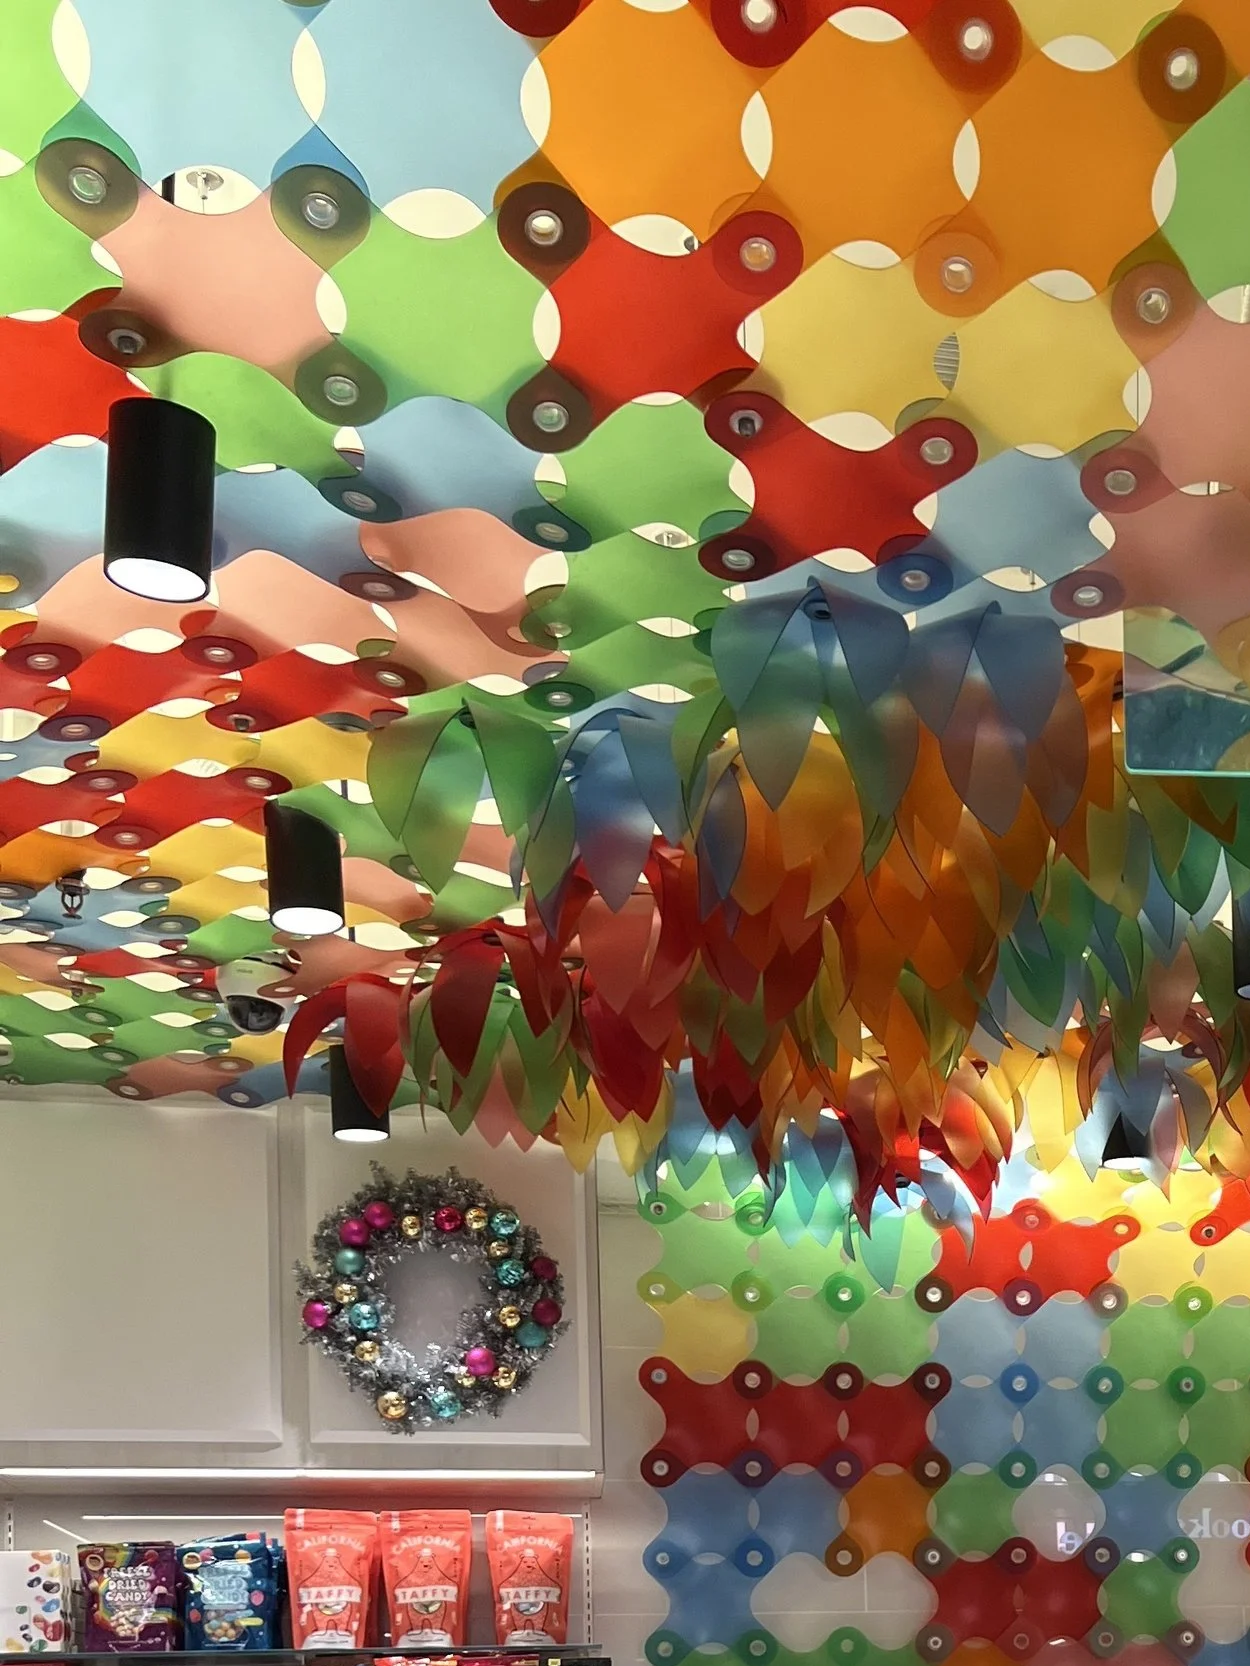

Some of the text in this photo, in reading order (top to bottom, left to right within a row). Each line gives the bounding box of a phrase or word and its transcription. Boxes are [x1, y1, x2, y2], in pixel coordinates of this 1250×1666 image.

[392, 1535, 461, 1554] CALIFORNIA
[108, 1578, 147, 1591] DRIED
[105, 1590, 149, 1602] CANDY
[306, 1588, 355, 1600] TAFFY
[402, 1588, 449, 1600] TAFFY
[505, 1589, 552, 1600] TAFFY
